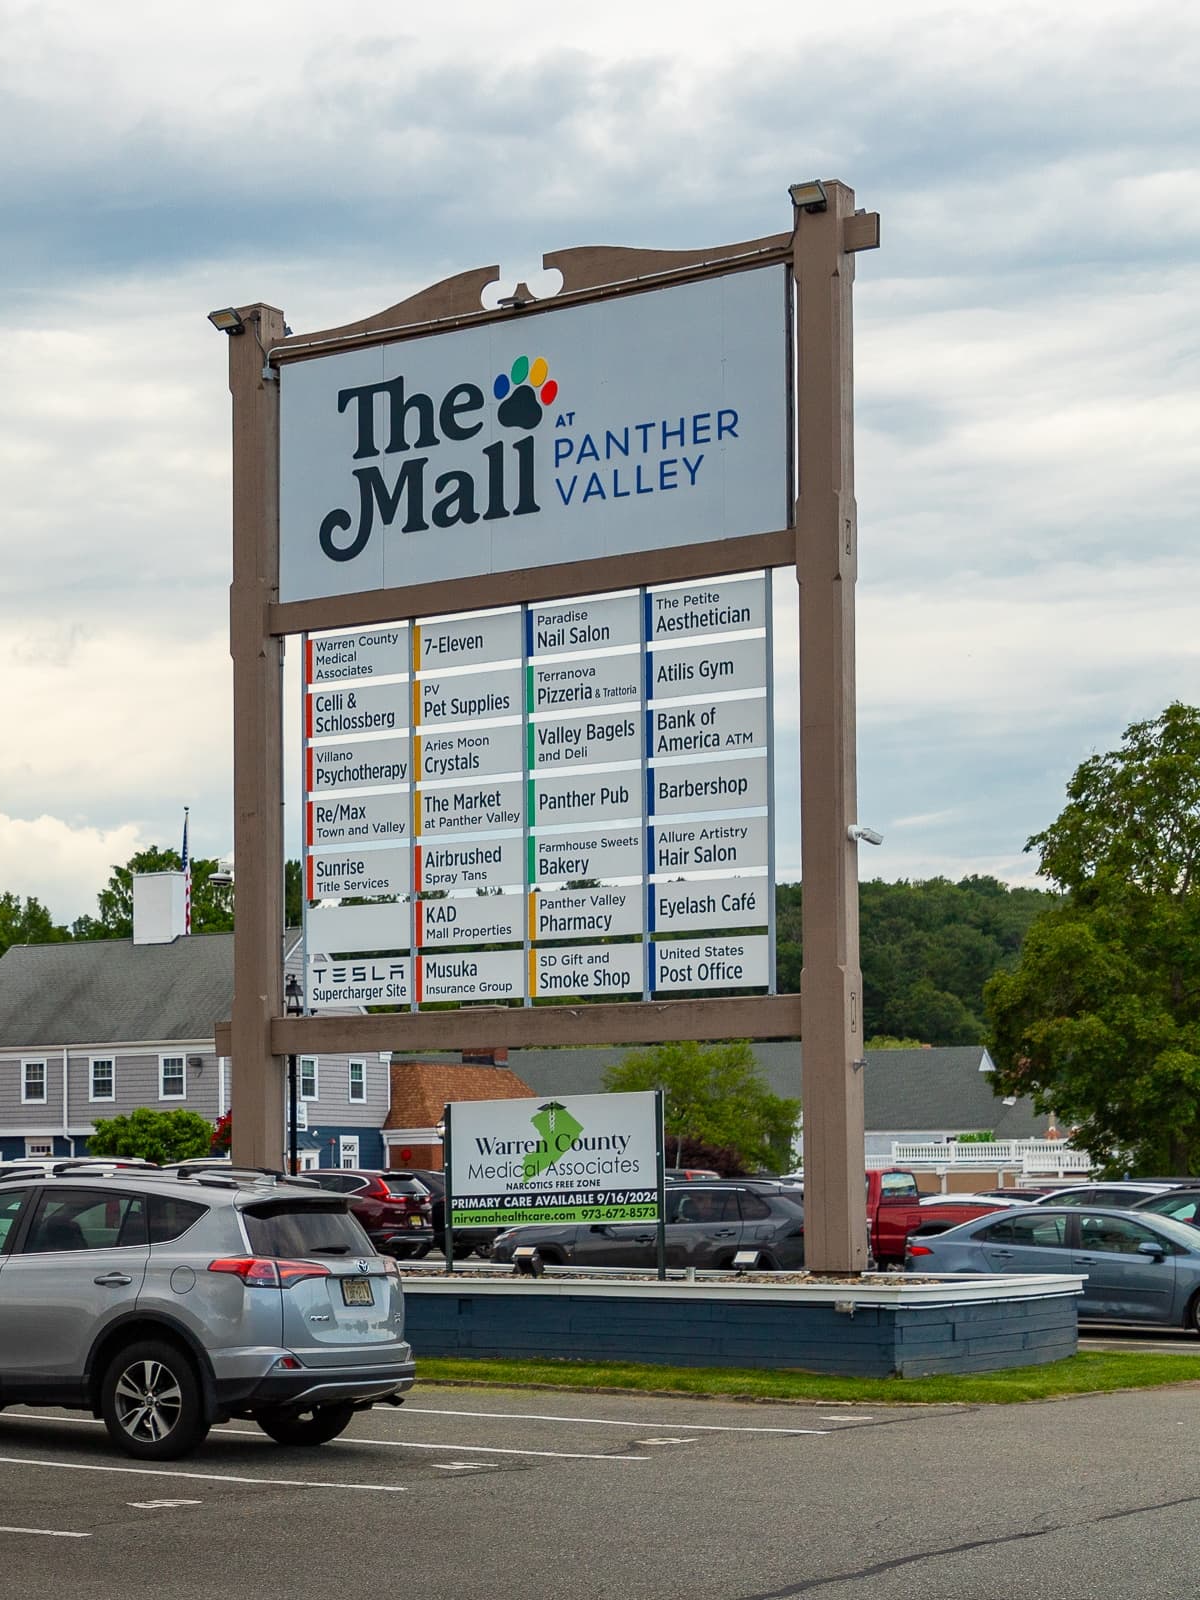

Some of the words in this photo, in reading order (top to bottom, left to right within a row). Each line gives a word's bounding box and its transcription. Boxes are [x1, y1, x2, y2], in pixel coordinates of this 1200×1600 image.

[337, 374, 485, 460] The
[555, 411, 576, 429] AT
[554, 407, 741, 468] PANTHER
[555, 454, 705, 506] VALLEY
[318, 435, 542, 562] Mall
[656, 597, 679, 610] The
[683, 591, 720, 606] Petite
[537, 610, 588, 626] Paradise
[656, 607, 751, 633] Aesthetician
[316, 640, 355, 652] Warren
[358, 633, 398, 647] County
[424, 634, 484, 655] 7-Eleven
[537, 629, 565, 649] Nail
[569, 625, 610, 644] Salon
[316, 652, 357, 666] Medical
[316, 664, 373, 680] Associates
[537, 667, 596, 683] Terranova
[657, 662, 694, 683] Atilis
[699, 659, 735, 681] Gym
[424, 684, 440, 696] PV
[537, 683, 593, 705] Pizzeria
[595, 688, 601, 699] &
[603, 685, 637, 698] Trattoria
[316, 694, 343, 713] Celli
[347, 693, 357, 709] &
[424, 701, 447, 718] Pet
[451, 693, 510, 715] Supplies
[316, 711, 395, 733] Schlossberg
[657, 711, 696, 731] Bank
[700, 707, 717, 726] of
[538, 726, 582, 746] Valley
[586, 720, 635, 742] Bagels
[657, 731, 720, 753] America
[725, 732, 753, 746] ATM
[425, 738, 454, 752] Aries
[457, 735, 490, 748] Moon
[316, 751, 353, 763] Villano
[538, 750, 560, 762] and
[565, 746, 588, 760] Deli
[425, 752, 480, 776] Crystals
[316, 762, 407, 786] Psychotherapy
[659, 776, 748, 800] Barbershop
[424, 795, 449, 814] The
[453, 790, 502, 811] Market
[539, 790, 596, 811] Panther
[600, 786, 629, 805] Pub
[316, 803, 366, 824] Re/Max
[424, 818, 436, 829] at
[439, 814, 483, 828] Panther
[486, 810, 520, 825] Valley
[317, 827, 345, 838] Town
[348, 824, 369, 835] and
[372, 822, 406, 836] Valley
[658, 830, 695, 844] Allure
[699, 825, 748, 840] Artistry
[539, 840, 598, 853] Farmhouse
[601, 836, 639, 848] Sweets
[425, 846, 502, 868] Airbrushed
[659, 847, 690, 867] Hair
[694, 844, 737, 864] Salon
[316, 858, 365, 877] Sunrise
[539, 857, 590, 876] Bakery
[317, 881, 341, 893] Title
[344, 878, 390, 890] Services
[425, 872, 458, 886] Spray
[461, 870, 488, 882] Tans
[539, 896, 587, 910] Panther
[590, 894, 626, 908] Valley
[659, 895, 717, 918] Eyelash
[721, 892, 756, 912] Café
[426, 905, 457, 924] KAD
[539, 913, 613, 933] Pharmacy
[426, 927, 449, 940] Mall
[452, 924, 512, 939] Properties
[540, 955, 557, 967] SD
[561, 953, 584, 966] Gift
[587, 951, 610, 964] and
[660, 946, 701, 960] United
[704, 945, 744, 958] States
[312, 964, 404, 984] TESLA
[426, 960, 478, 979] Musuka
[660, 964, 693, 983] Post
[697, 961, 743, 981] Office
[426, 983, 476, 995] Insurance
[479, 980, 513, 993] Group
[540, 970, 589, 990] Smoke
[593, 969, 631, 989] Shop
[312, 985, 384, 1002] Supercharger
[386, 983, 407, 997] Site
[475, 1136, 548, 1156] Warren
[555, 1133, 631, 1155] County
[468, 1160, 540, 1180] Medical
[545, 1156, 640, 1177] Associates
[506, 1181, 553, 1191] NARCOTICS
[555, 1180, 575, 1188] FREE
[577, 1179, 601, 1188] ZONE
[451, 1197, 500, 1209] PRIMARY
[504, 1196, 532, 1208] CARE
[535, 1192, 594, 1206] AVAILABLE
[597, 1191, 658, 1205] 9/16/2024
[454, 1211, 576, 1224] nirvanahealthcare.com
[581, 1207, 656, 1220] 973-672-8573
